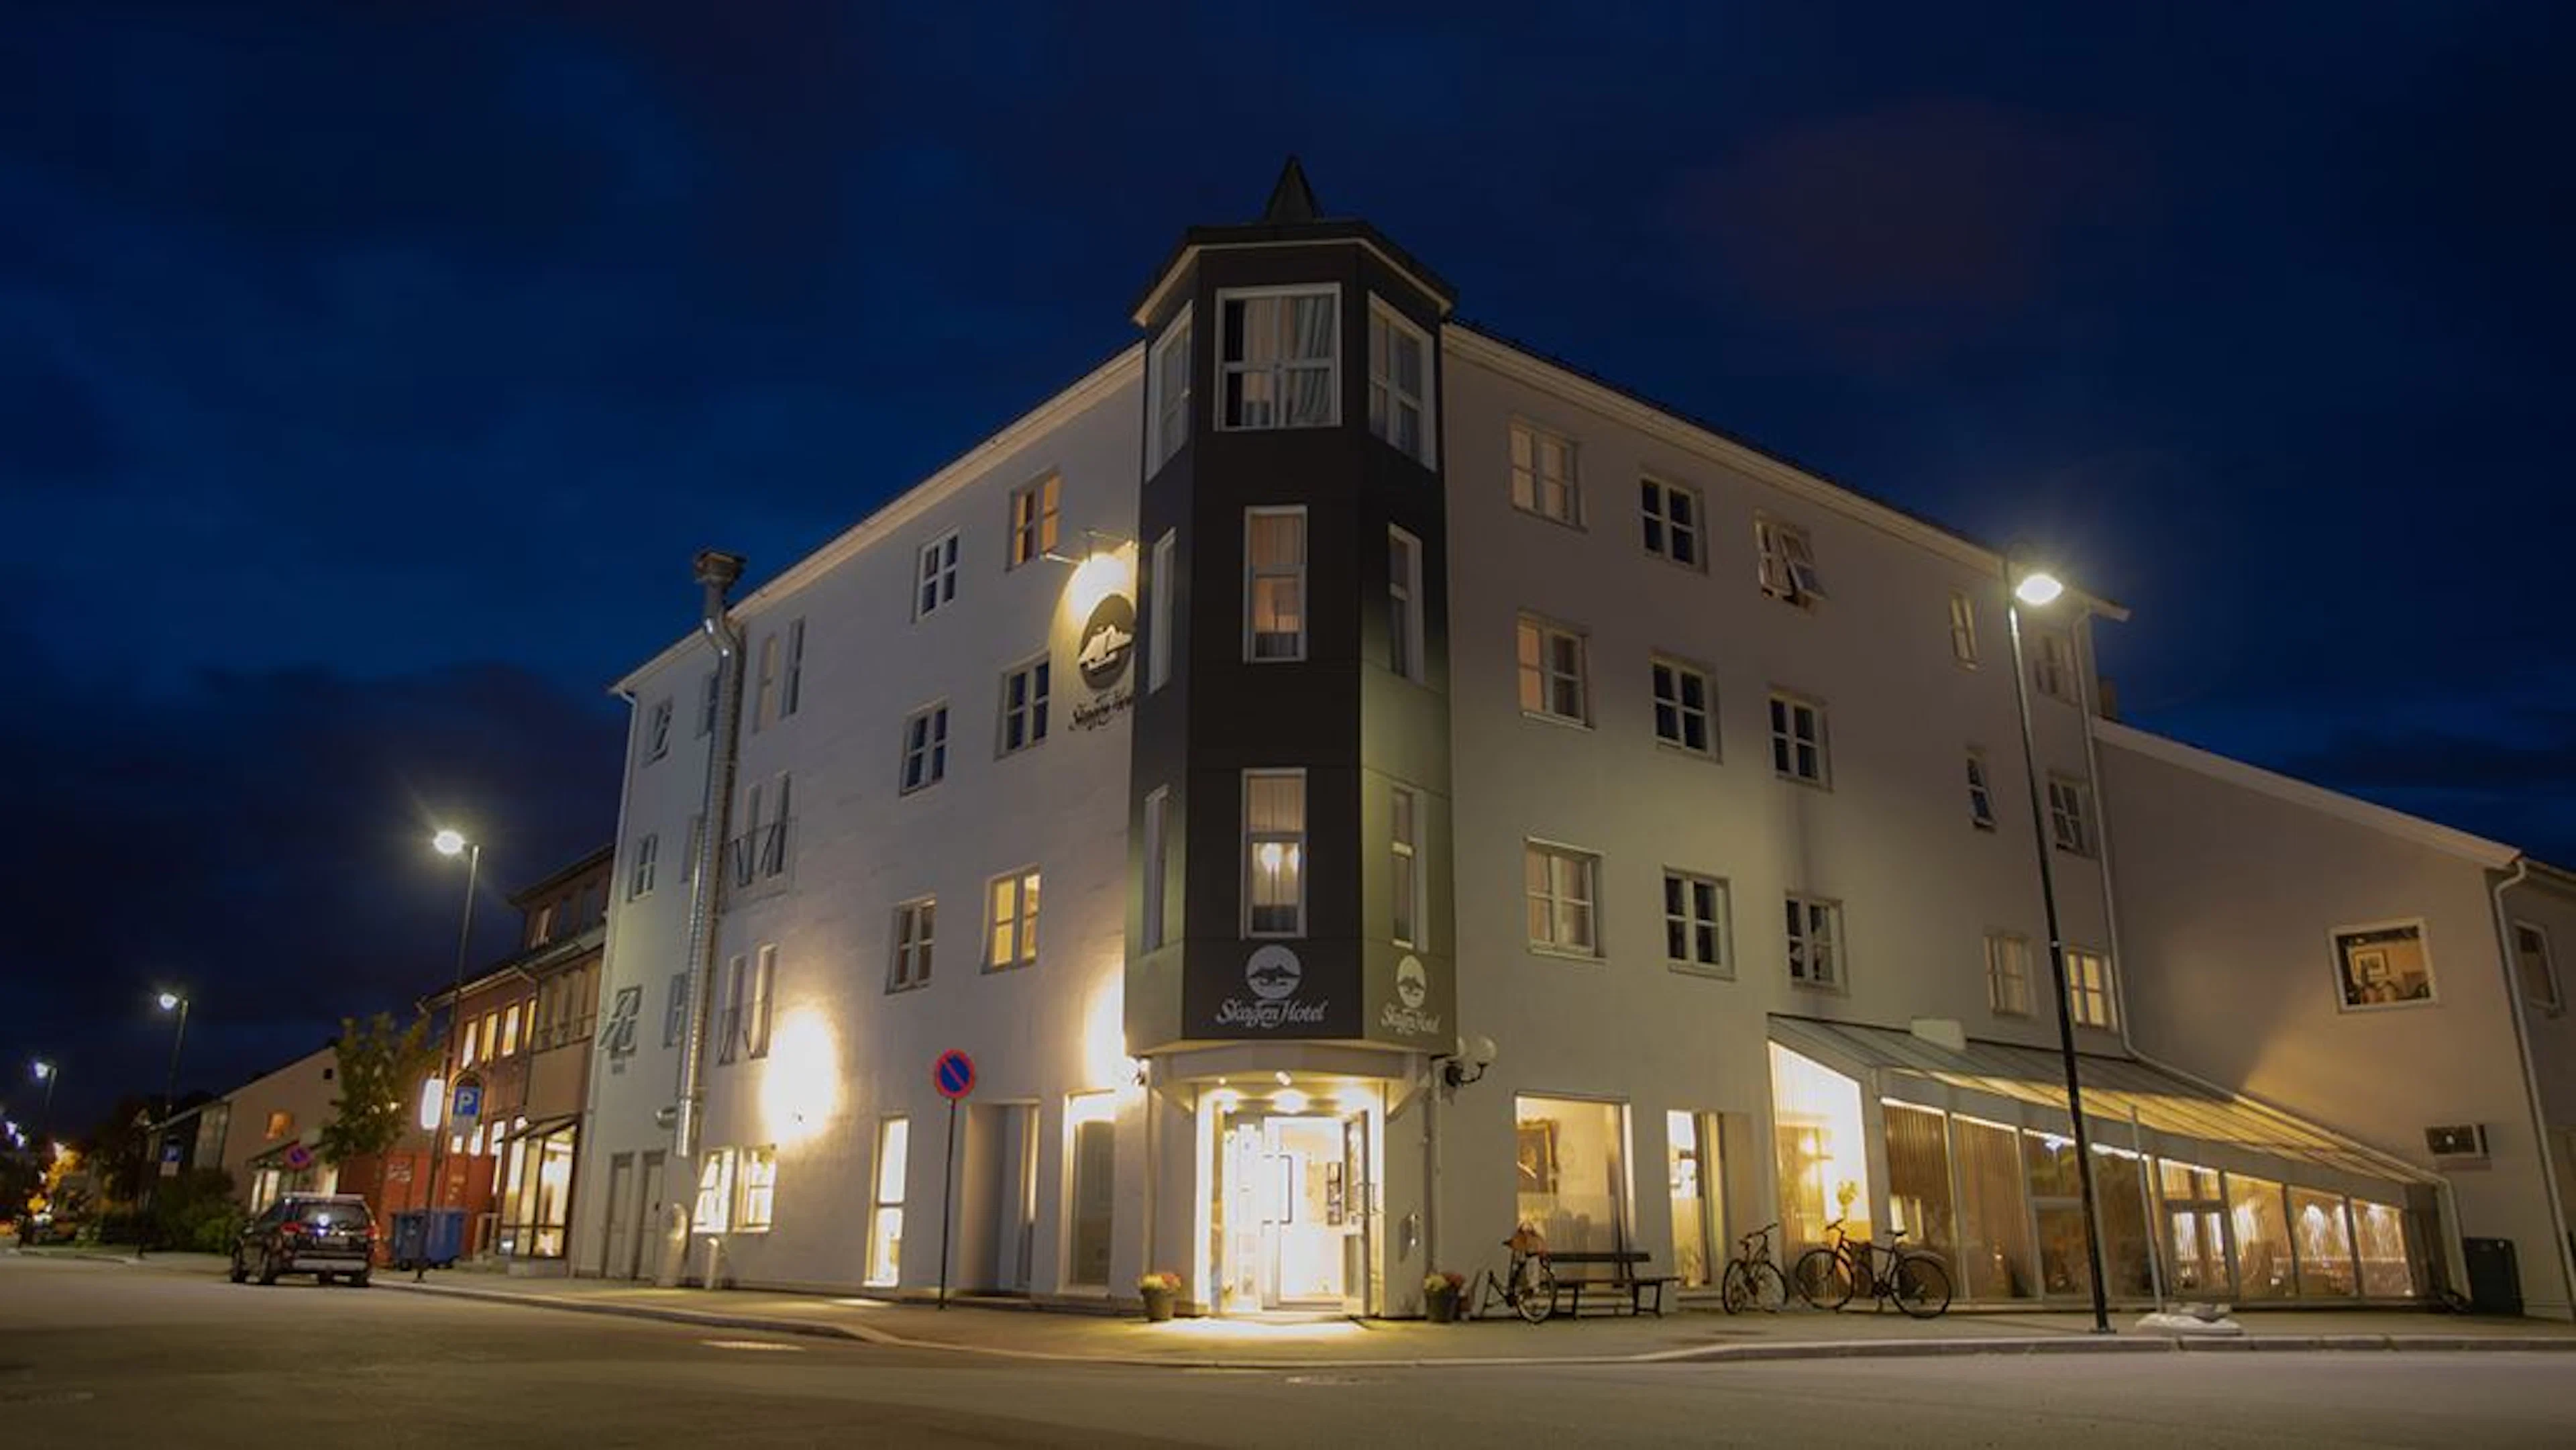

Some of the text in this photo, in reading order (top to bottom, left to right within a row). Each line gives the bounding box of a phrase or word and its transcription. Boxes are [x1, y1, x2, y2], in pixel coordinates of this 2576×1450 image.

[1216, 997, 1330, 1029] Skagen Hotel
[458, 1091, 474, 1113] P
